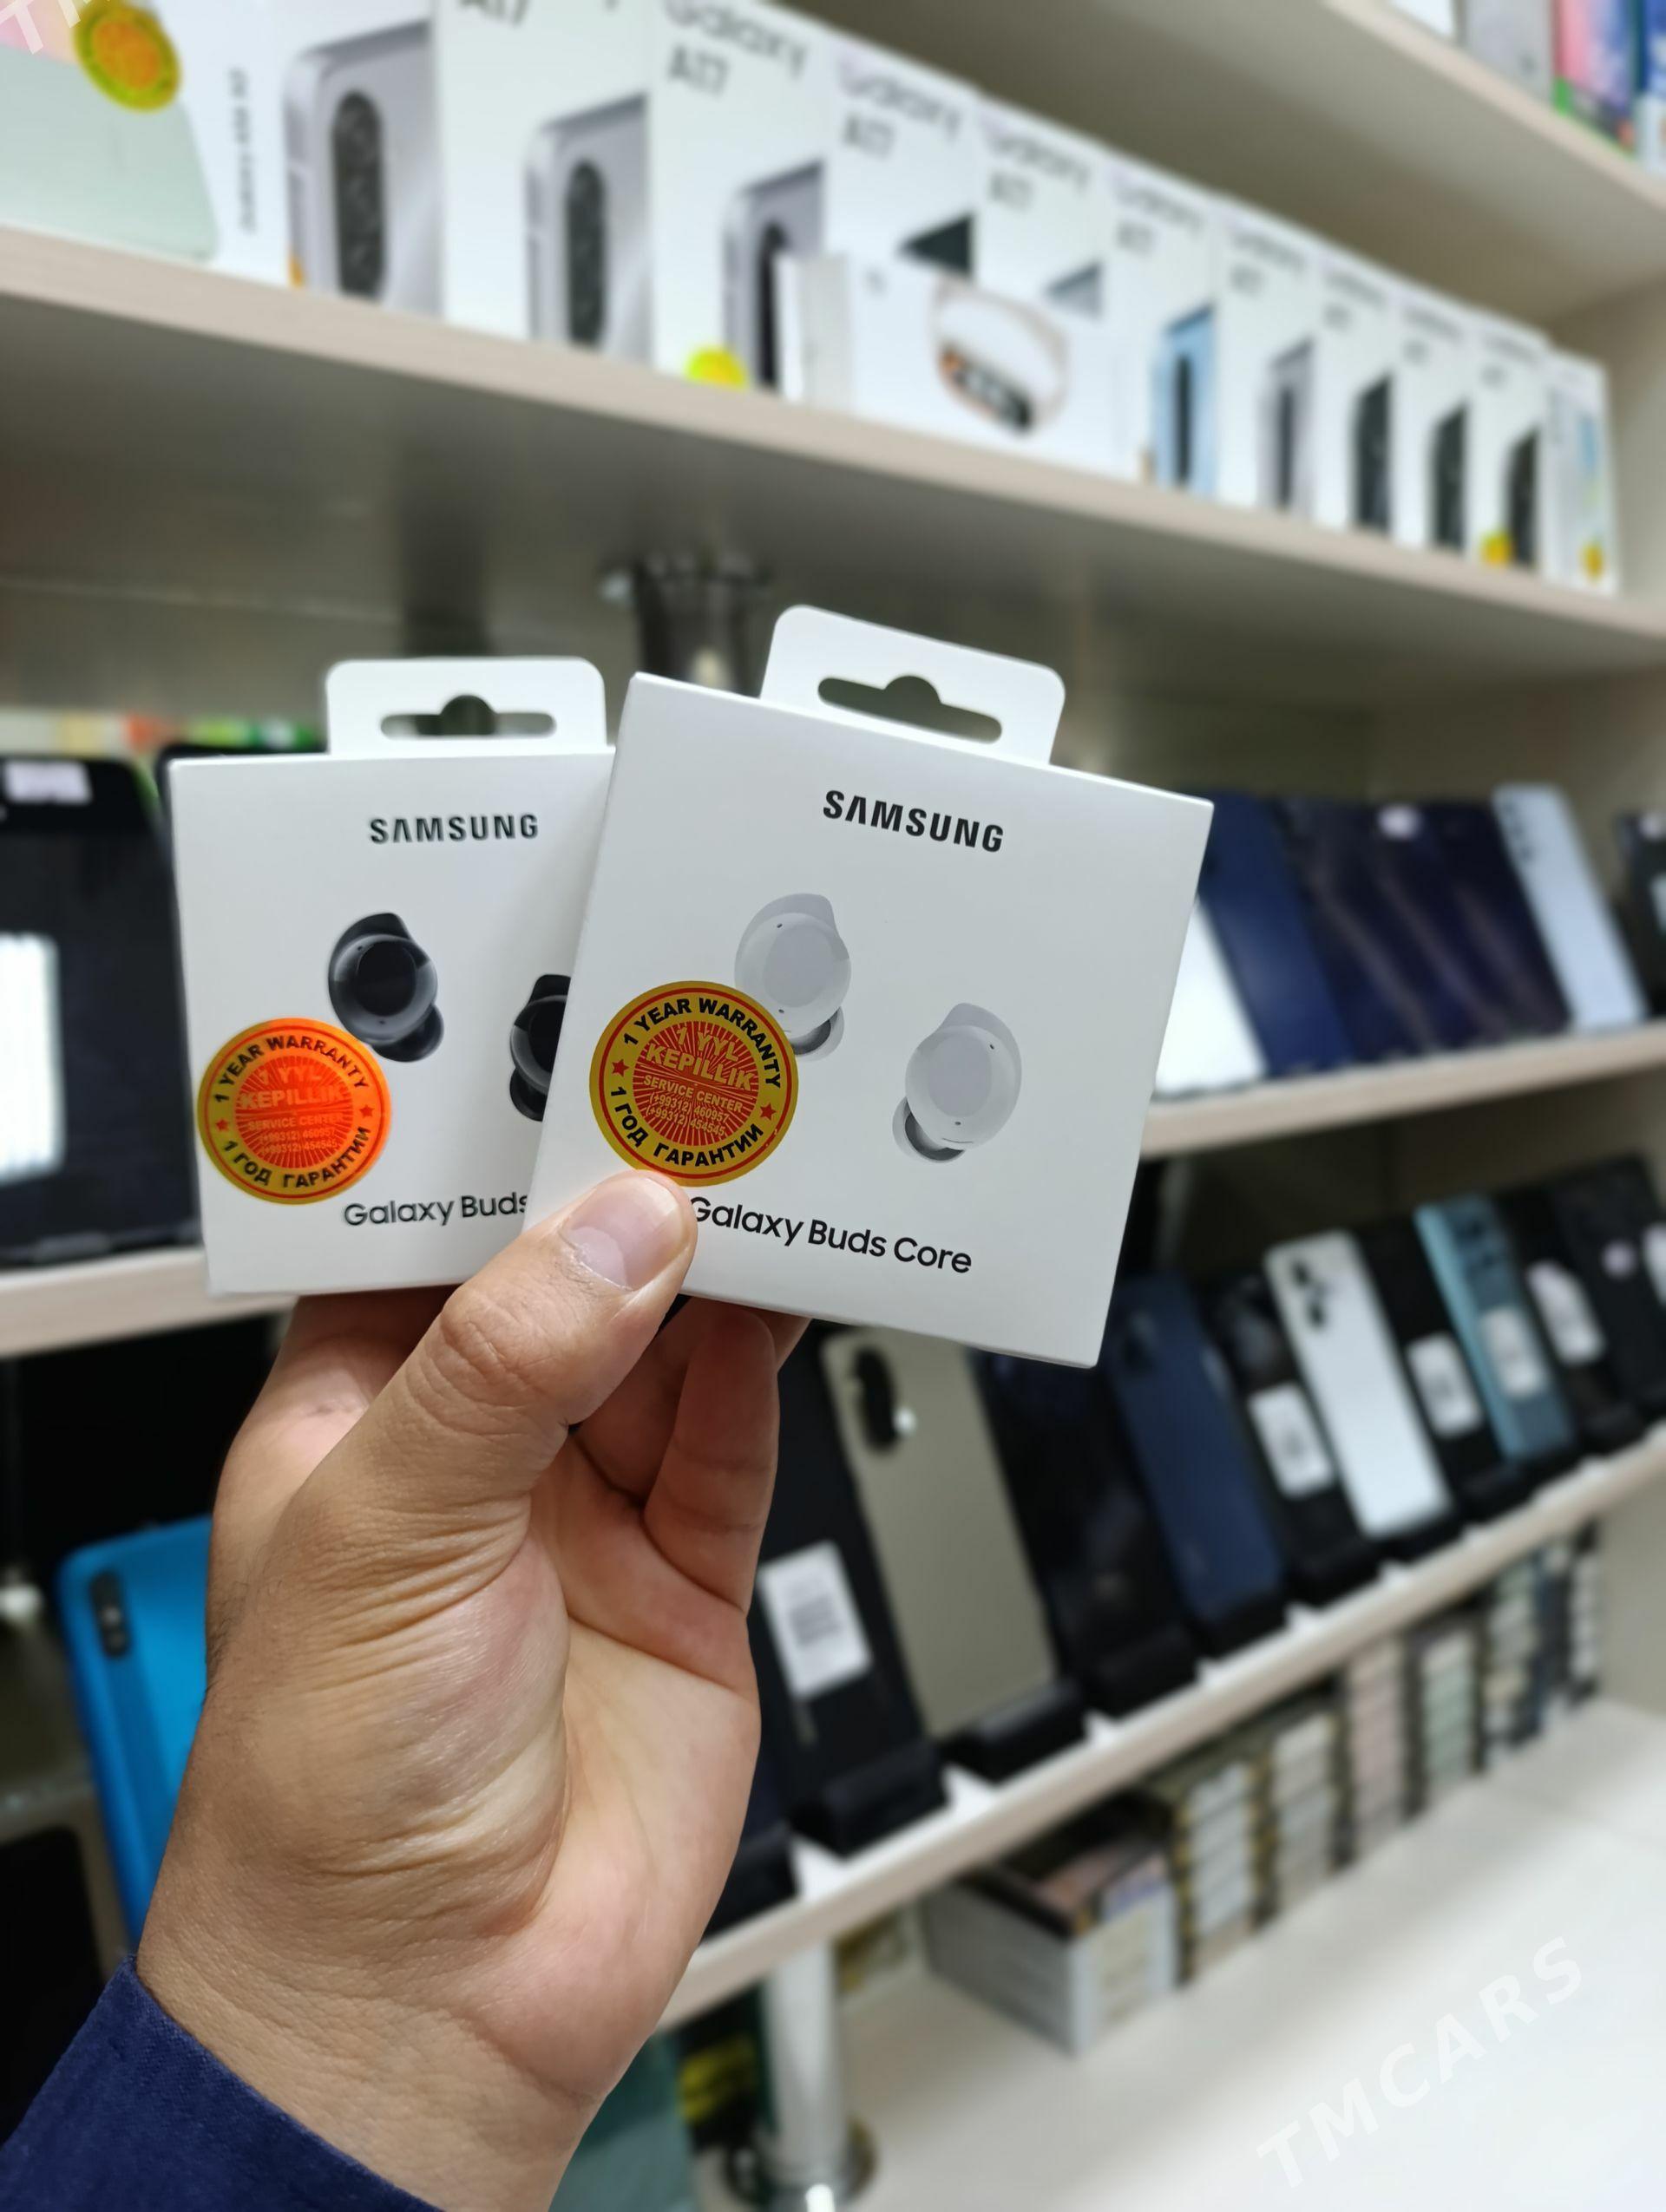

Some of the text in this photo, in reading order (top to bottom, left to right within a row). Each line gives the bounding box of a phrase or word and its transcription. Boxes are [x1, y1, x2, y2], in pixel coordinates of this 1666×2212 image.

[666, 43, 731, 96] A17
[369, 814, 539, 845] SAMSUNG
[822, 789, 1005, 854] SAMSUNG
[624, 998, 781, 1089] 1 YEAR WARRANTY
[677, 1026, 688, 1046] 1
[214, 1036, 370, 1103] 1 YEAR WARRANTY
[646, 1043, 755, 1091] KEPILLIK
[239, 1084, 344, 1109] KEPILLIK
[644, 1075, 744, 1112] SERVICE CENTER
[649, 1092, 729, 1123] (+99312) 460957
[247, 1112, 344, 1130] SERVICE CENTER
[610, 1086, 764, 1167] 1 ГОД ГАРАНТИИ
[646, 1105, 726, 1136] (+99312) 454545
[223, 1127, 371, 1188] 1 ГОД ГАРАНТИИ
[344, 1191, 528, 1227] Galaxy Buds
[689, 1195, 972, 1273] Galaxy Buds Core
